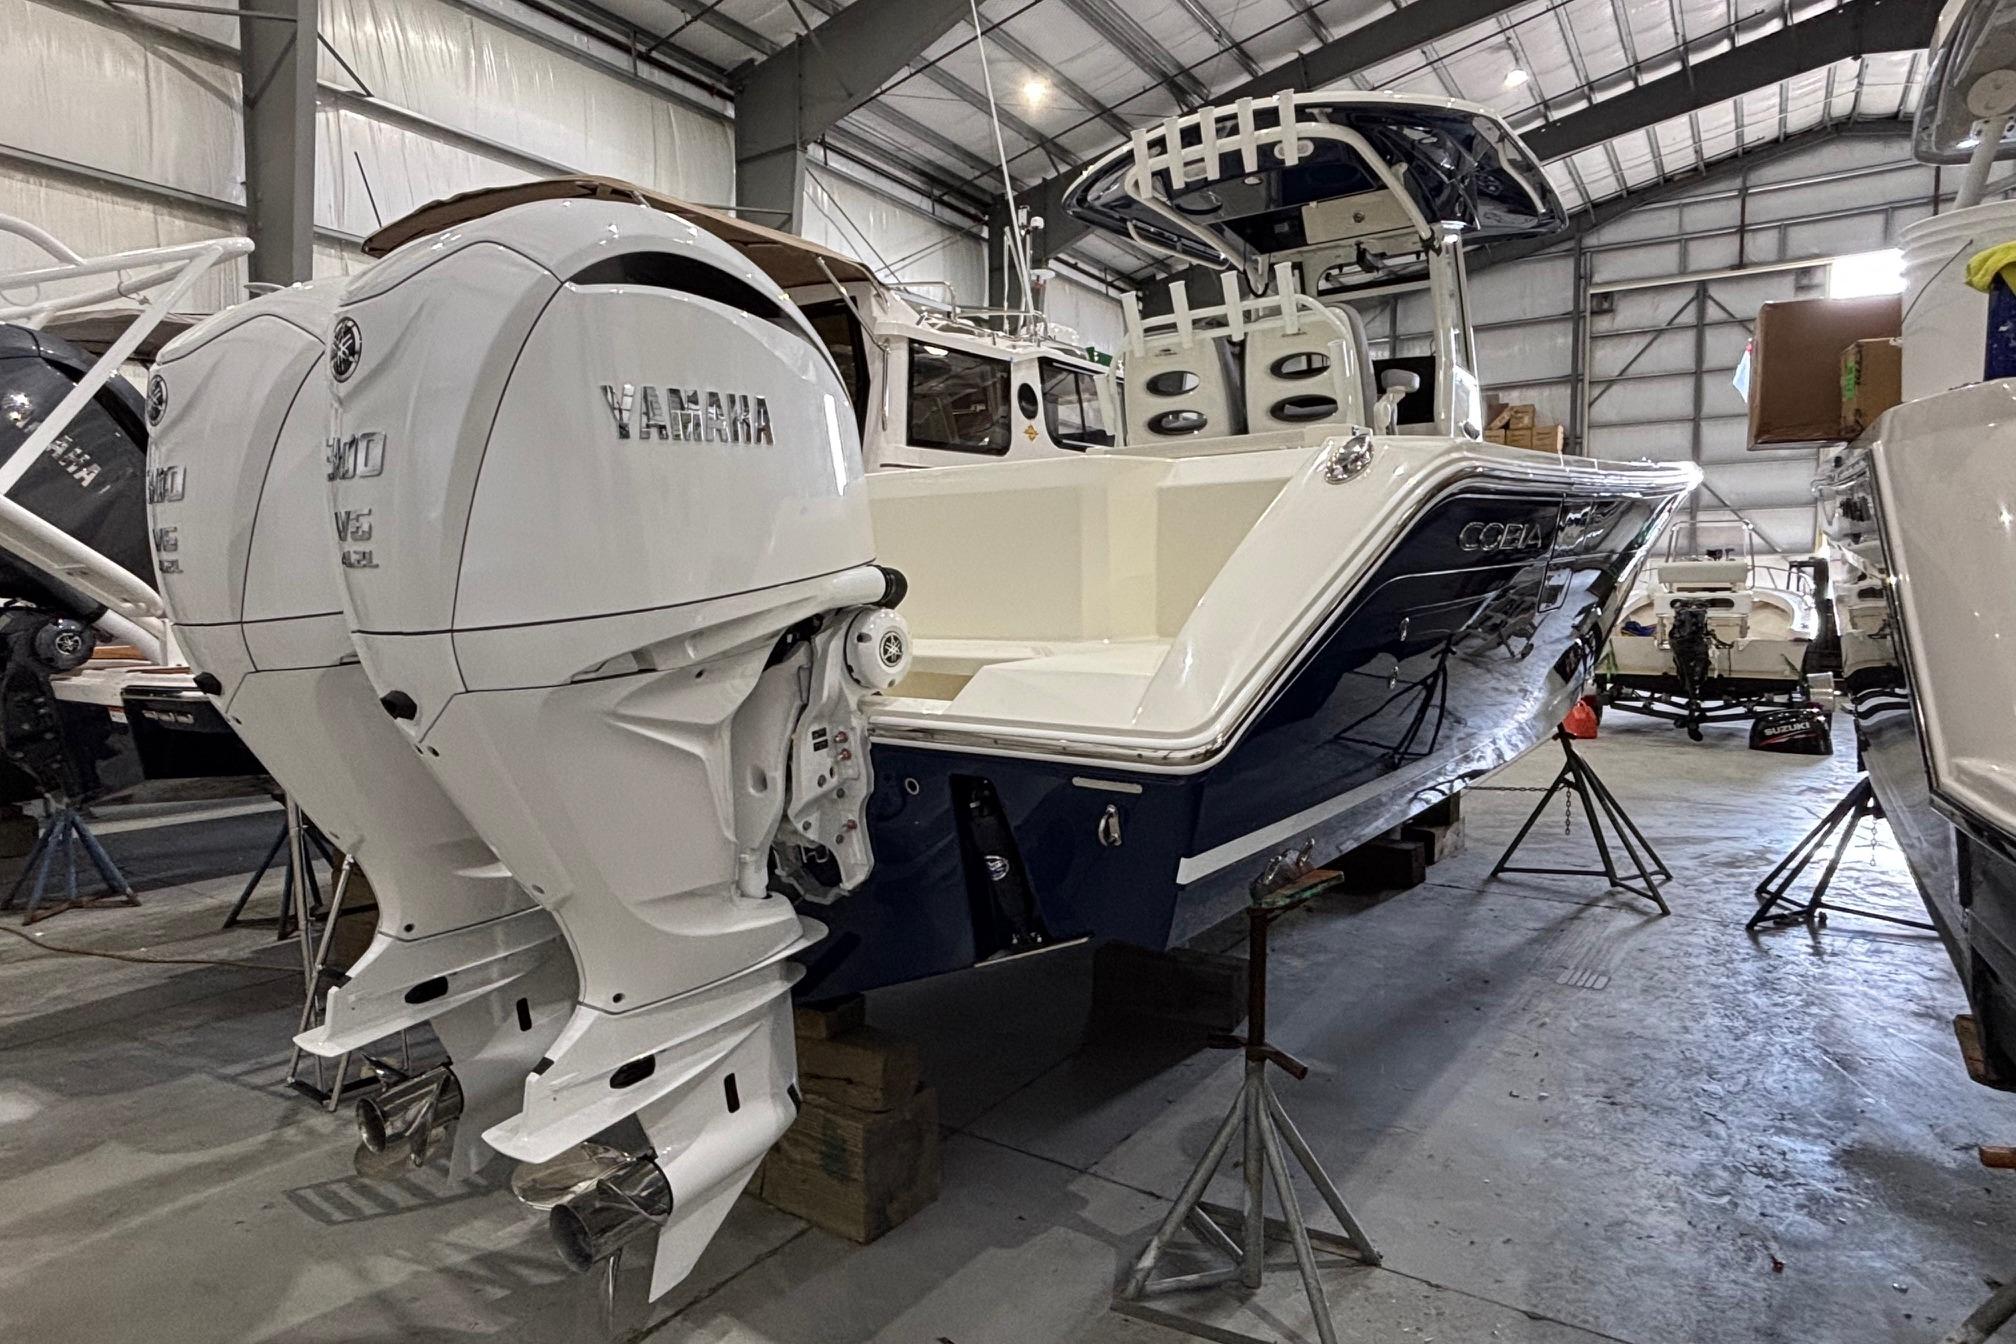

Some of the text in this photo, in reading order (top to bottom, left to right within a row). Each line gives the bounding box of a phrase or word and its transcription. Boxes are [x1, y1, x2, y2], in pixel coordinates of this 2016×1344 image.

[600, 384, 775, 446] YAMAHA
[1459, 521, 1542, 552] COBIA
[1763, 721, 1811, 736] SUZUKI
